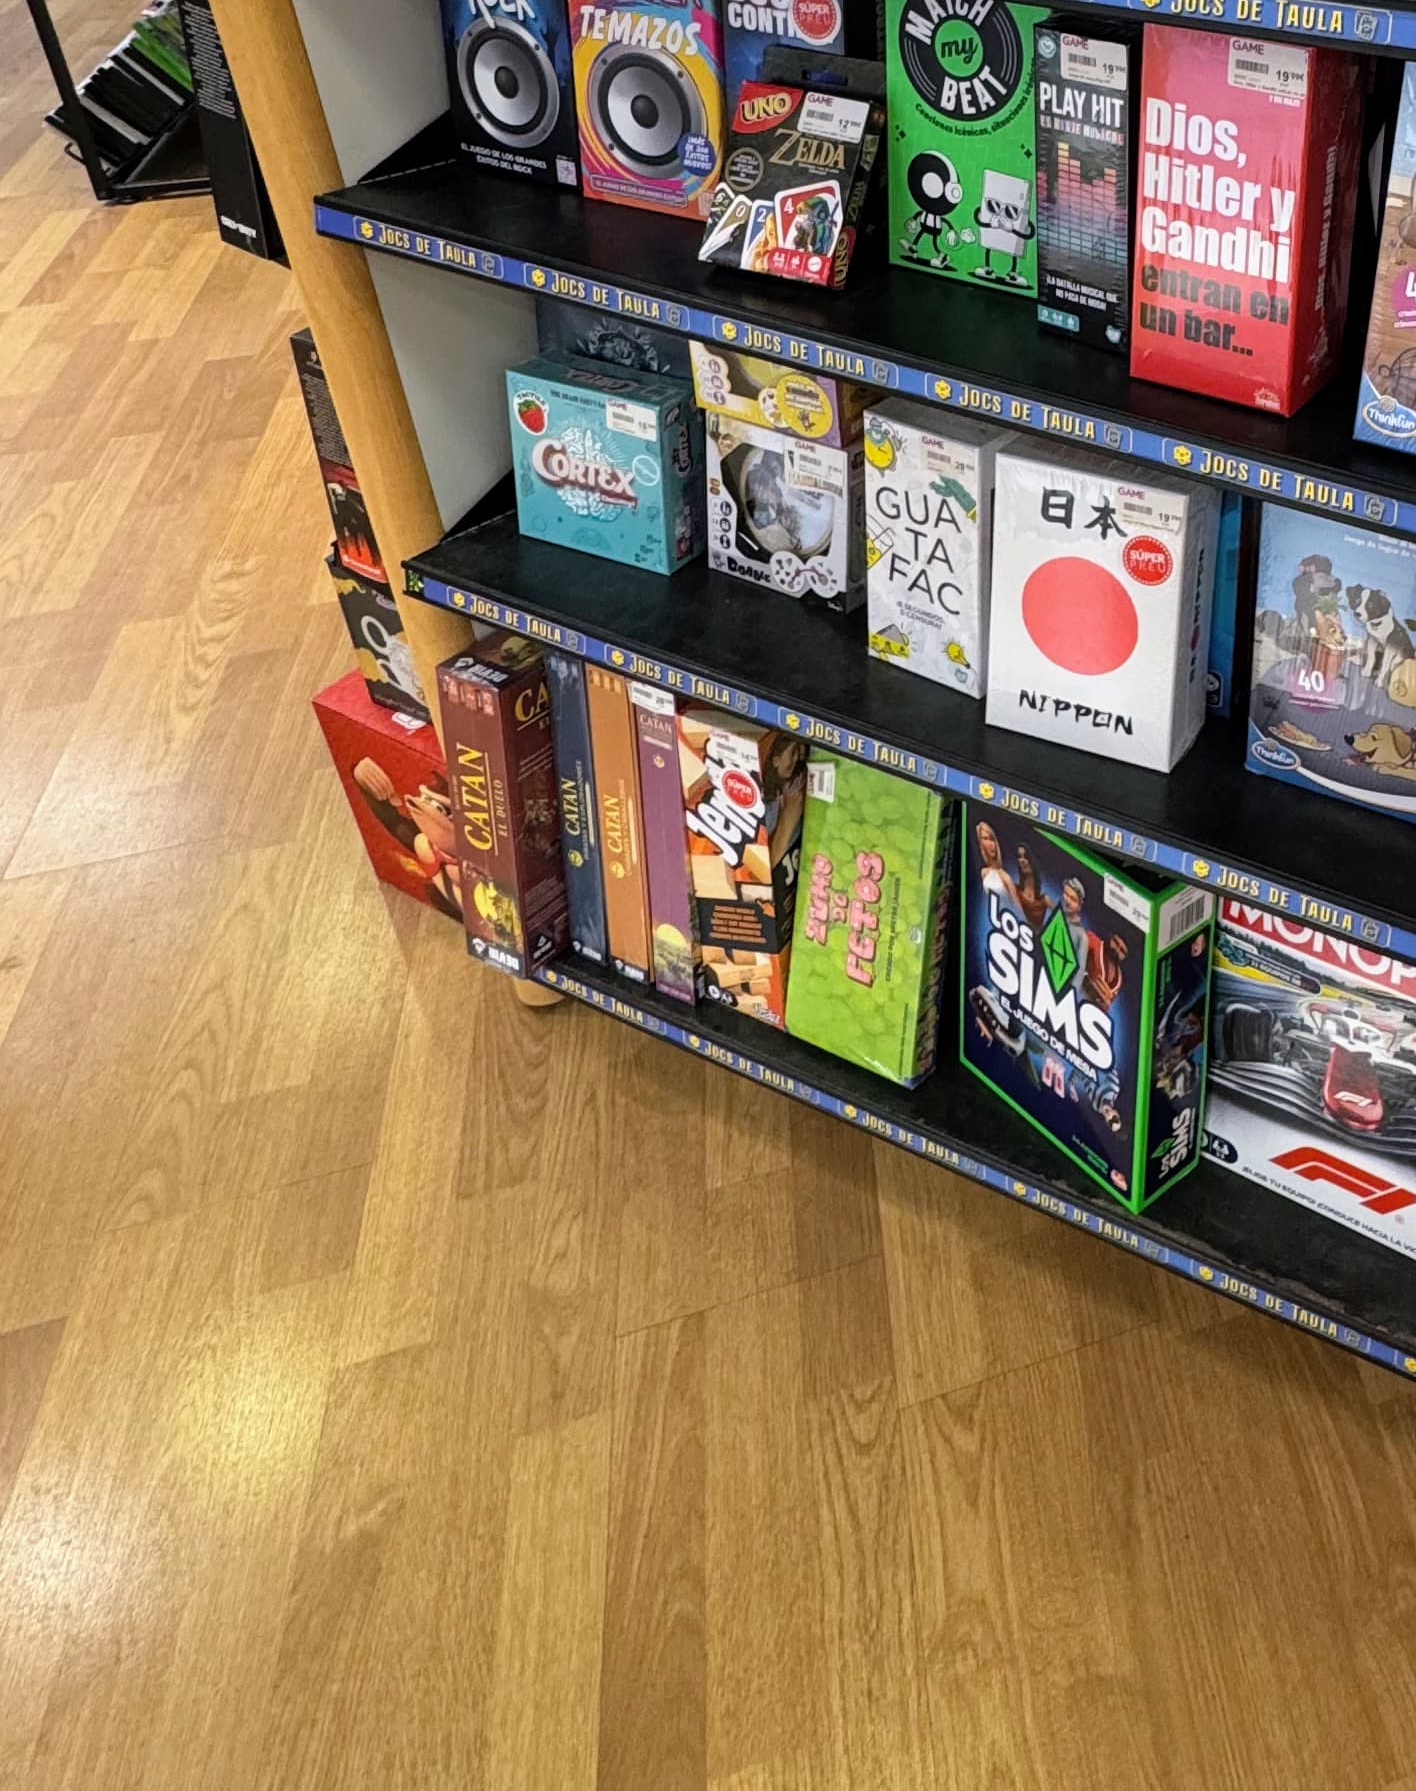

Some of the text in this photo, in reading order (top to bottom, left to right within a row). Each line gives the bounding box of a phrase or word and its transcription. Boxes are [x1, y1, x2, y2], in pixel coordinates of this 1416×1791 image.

[580, 5, 701, 56] TEMAZOS
[941, 40, 979, 64] my
[741, 93, 792, 123] UNO
[941, 65, 1008, 115] BEAT
[1039, 82, 1125, 129] PLAY HIT
[769, 128, 846, 170] ZELDA
[1144, 96, 1247, 170] Dios,
[784, 196, 794, 215] 4
[1143, 151, 1296, 234] Hitler y
[378, 222, 476, 268] JOCS DE TAULA
[1141, 205, 1291, 284] Gandhi
[1141, 263, 1289, 326] entran en
[1140, 300, 1255, 357] un bar...
[532, 437, 638, 495] CORTEX
[874, 485, 962, 534] GUA
[1040, 485, 1129, 540] 日本
[903, 527, 955, 574] TA
[888, 556, 964, 617] FAC
[470, 593, 562, 644] JOCS DE TAULA
[1297, 670, 1326, 694] 40
[639, 714, 673, 735] CATAN
[1018, 688, 1135, 736] NIPPON
[456, 741, 494, 851] CATAN
[561, 777, 580, 836] CATAN
[603, 793, 622, 854] CATAN
[988, 892, 1035, 954] LOS
[1217, 864, 1353, 932] JOCS DE TAULA
[987, 931, 1116, 1072] SIMS
